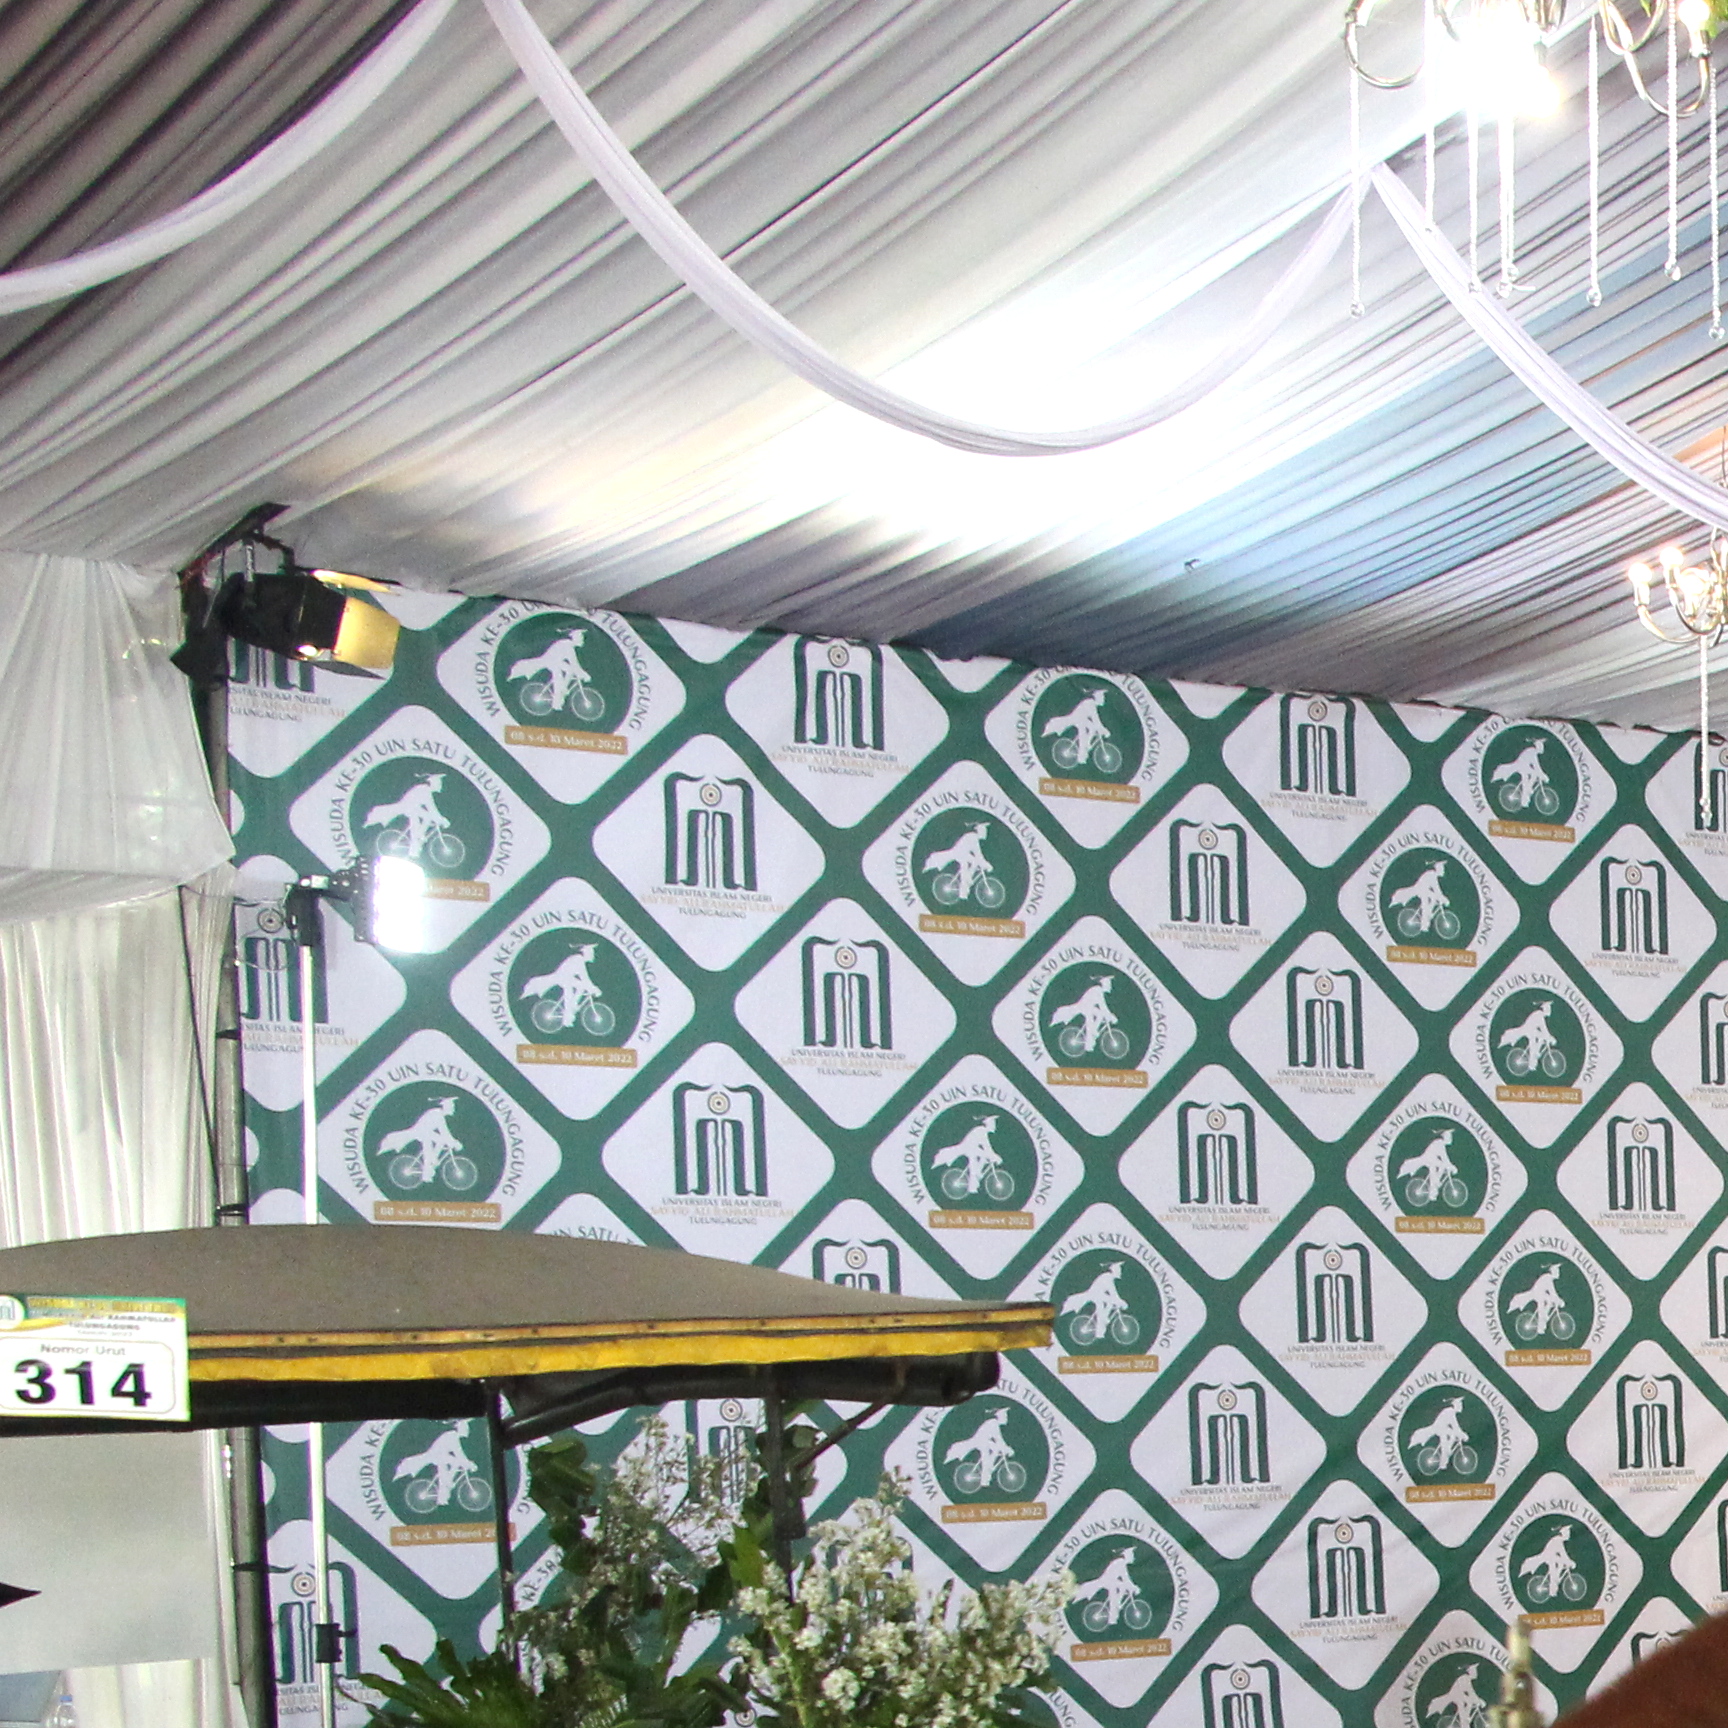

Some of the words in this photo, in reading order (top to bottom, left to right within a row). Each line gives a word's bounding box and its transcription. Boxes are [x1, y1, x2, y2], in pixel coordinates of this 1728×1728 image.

[482, 608, 517, 646] KE-30
[475, 652, 500, 716] WISUDA
[602, 613, 651, 730] TULUNGAGUNG
[1021, 671, 1051, 705] KE-30
[598, 738, 623, 749] 2022
[1015, 711, 1035, 769] WISUDA
[1121, 675, 1160, 781] TULUNGAGUNG
[1473, 721, 1498, 753] KE-30
[374, 739, 407, 756] UIN
[413, 739, 457, 760] SATU
[335, 753, 372, 791] KE-30
[1468, 759, 1485, 813] WISUDA
[1557, 724, 1592, 822] TULUNGAGUNG
[461, 755, 514, 875] TULUNGAGUNG
[932, 792, 959, 807] UIN
[964, 791, 1000, 809] SATU
[329, 798, 356, 864] WISUDA
[900, 804, 930, 840] KE-30
[1397, 833, 1420, 847] UIN
[1425, 832, 1455, 849] SATU
[894, 846, 916, 906] WISUDA
[1003, 806, 1045, 915] TULUNGAGUNG
[1370, 845, 1396, 878] KE-30
[1365, 883, 1383, 938] WISUDA
[1458, 846, 1494, 946] TULUNGAGUNG
[532, 911, 562, 928] UIN
[568, 910, 609, 929] SATU
[495, 925, 529, 965] KE-30
[1059, 946, 1084, 962] UIN
[1089, 945, 1123, 963] SATU
[612, 925, 660, 1043] TULUNGAGUNG
[1028, 960, 1057, 996] KE-30
[1506, 974, 1528, 988] UIN
[1532, 973, 1561, 989] SATU
[488, 971, 513, 1036] WISUDA
[1126, 958, 1167, 1065] TULUNGAGUNG
[1480, 986, 1505, 1019] KE-30
[1023, 1001, 1043, 1061] WISUDA
[1564, 985, 1598, 1083] TULUNGAGUNG
[608, 1053, 632, 1063] 2022
[1475, 1025, 1493, 1079] WISUDA
[388, 1065, 420, 1082] UIN
[426, 1064, 470, 1082] SATU
[348, 1080, 385, 1120] KE-30
[941, 1086, 967, 1102] UIN
[972, 1085, 1008, 1102] SATU
[1405, 1102, 1428, 1117] UIN
[1432, 1101, 1462, 1117] SATU
[474, 1077, 525, 1195] TULUNGAGUNG
[909, 1100, 939, 1137] KE-30
[1378, 1115, 1403, 1149] KE-30
[342, 1126, 369, 1192] WISUDA
[1011, 1097, 1053, 1205] TULUNGAGUNG
[1465, 1112, 1501, 1212] TULUNGAGUNG
[903, 1143, 925, 1204] WISUDA
[1373, 1155, 1392, 1210] WISUDA
[471, 1206, 497, 1215] 2022
[1514, 1238, 1536, 1253] UIN
[1540, 1236, 1569, 1251] SATU
[1488, 1252, 1513, 1285] KE-30
[1038, 1249, 1067, 1286] KE-30
[1069, 1234, 1094, 1250] UIN
[1099, 1232, 1133, 1248] SATU
[1136, 1243, 1177, 1348] TULUNGAGUNG
[1572, 1246, 1607, 1343] TULUNGAGUNG
[1484, 1290, 1502, 1345] WISUDA
[40, 1343, 90, 1355] Nomor
[95, 1345, 126, 1356] Urut
[14, 1358, 152, 1407] 314
[1415, 1371, 1438, 1387] UIN
[1442, 1370, 1472, 1384] SATU
[1388, 1386, 1414, 1421] KE-30
[916, 1440, 937, 1499] WISUDA
[995, 1378, 1019, 1394] TU
[1024, 1390, 1066, 1495] TULUNGAGUNG
[1475, 1379, 1511, 1477] TULUNGAGUNG
[1384, 1426, 1403, 1481] WISUDA
[360, 1454, 386, 1520] WISUDA
[1525, 1501, 1546, 1517] UIN
[1550, 1499, 1579, 1513] SATU
[1499, 1516, 1523, 1550] KE-30
[1582, 1507, 1618, 1603] TULUNGAGUNG
[1051, 1537, 1080, 1575] KE-30
[1082, 1520, 1107, 1538] UIN
[1112, 1517, 1145, 1533] SATU
[1148, 1527, 1189, 1631] TULUNGAGUNG
[1496, 1555, 1514, 1609] WISUDA
[1428, 1641, 1451, 1657] UIN
[1455, 1639, 1486, 1652] SATU
